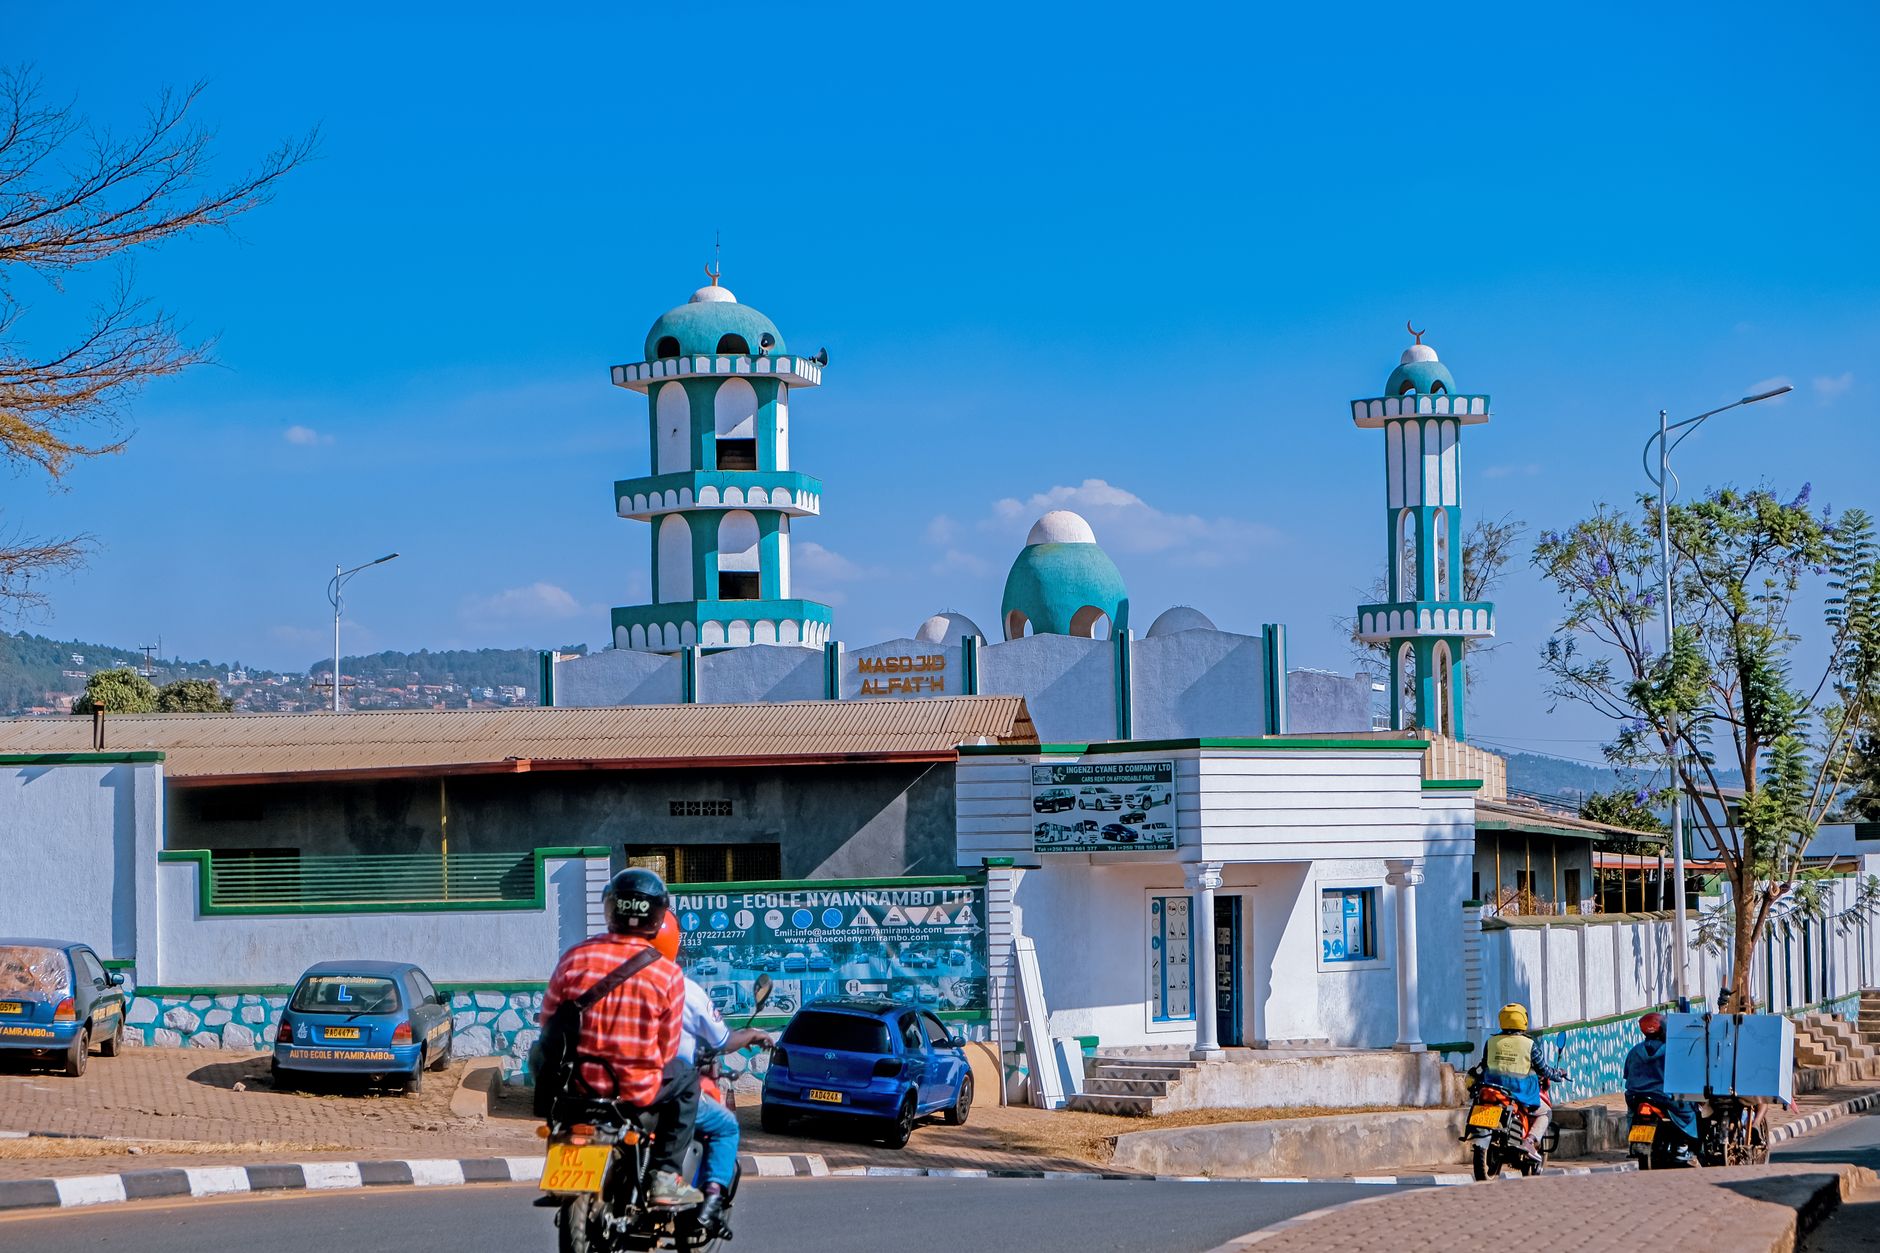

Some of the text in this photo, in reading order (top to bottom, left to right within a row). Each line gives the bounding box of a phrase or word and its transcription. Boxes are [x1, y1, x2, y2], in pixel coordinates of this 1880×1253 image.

[861, 676, 944, 694] ALFAT'H
[1095, 765, 1117, 773] CYANE
[1125, 764, 1157, 772] COMPANY
[617, 898, 650, 912] spiro
[678, 894, 727, 910] AUTO
[807, 891, 934, 907] NYAMIRAMBO
[942, 890, 981, 905] LTD.
[697, 930, 746, 939] 0722712777
[784, 934, 929, 944] www.autoecolenyamirambo.com
[338, 984, 352, 1001] L
[290, 1050, 308, 1058] AUTO
[310, 1050, 332, 1058] ECOLE
[334, 1050, 388, 1060] NYAMIRAMBO
[560, 1148, 583, 1166] RL
[548, 1170, 595, 1188] 677T
